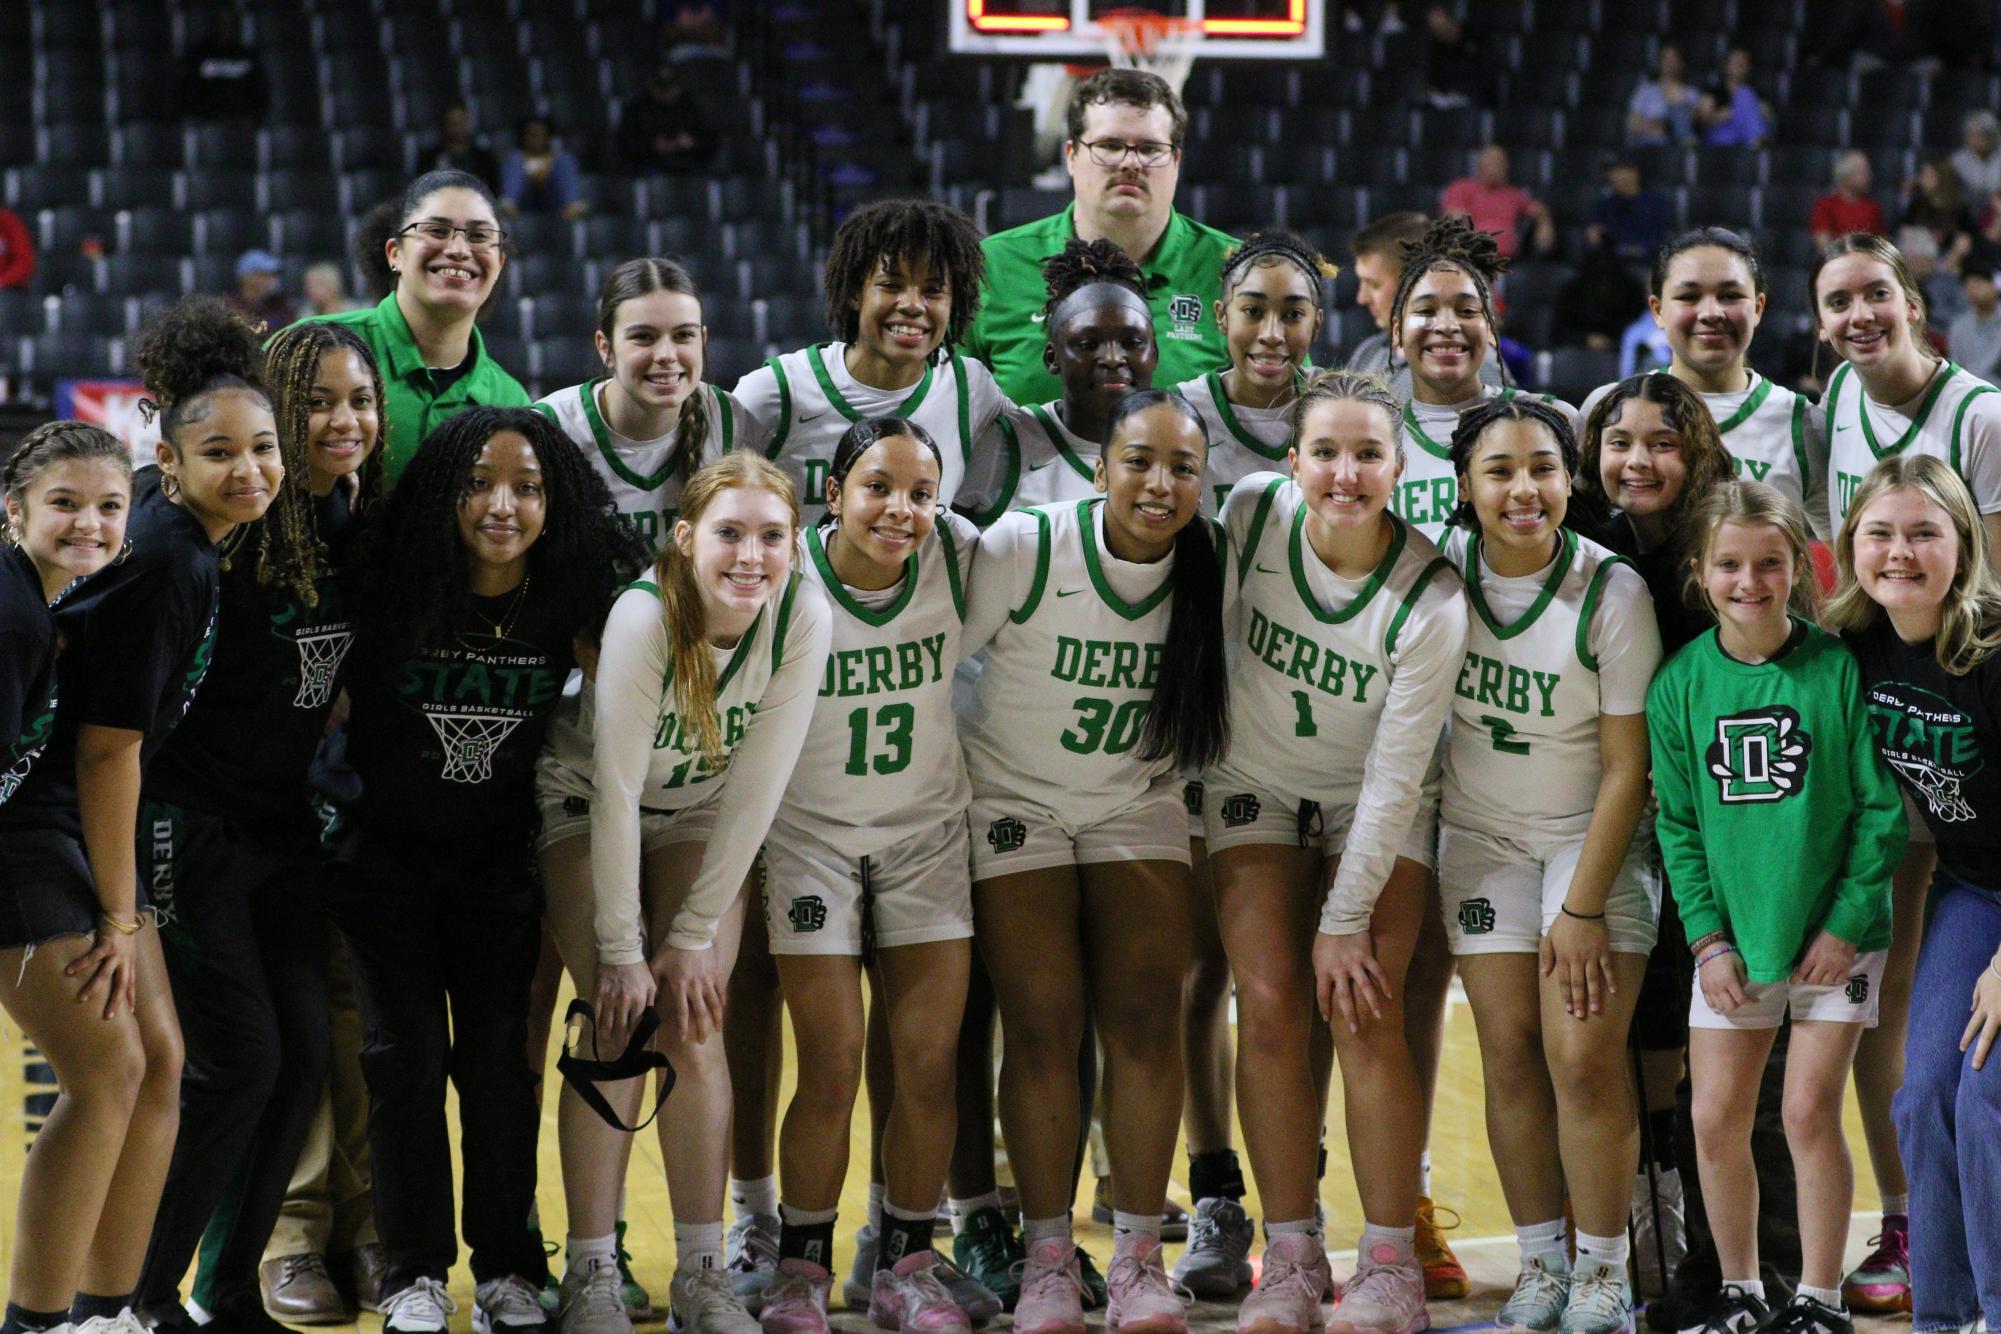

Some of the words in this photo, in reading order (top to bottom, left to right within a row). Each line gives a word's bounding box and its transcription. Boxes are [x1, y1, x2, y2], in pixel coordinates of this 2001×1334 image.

[466, 652, 546, 666] PANTHERS
[1248, 606, 1378, 703] DERBY
[400, 659, 558, 706] STATE
[422, 703, 457, 713] GIRLS
[460, 705, 535, 717] BASKETBALL
[1060, 697, 1152, 755] 30
[1290, 690, 1317, 737] 1
[845, 702, 915, 776] 13
[1480, 715, 1531, 756] 2
